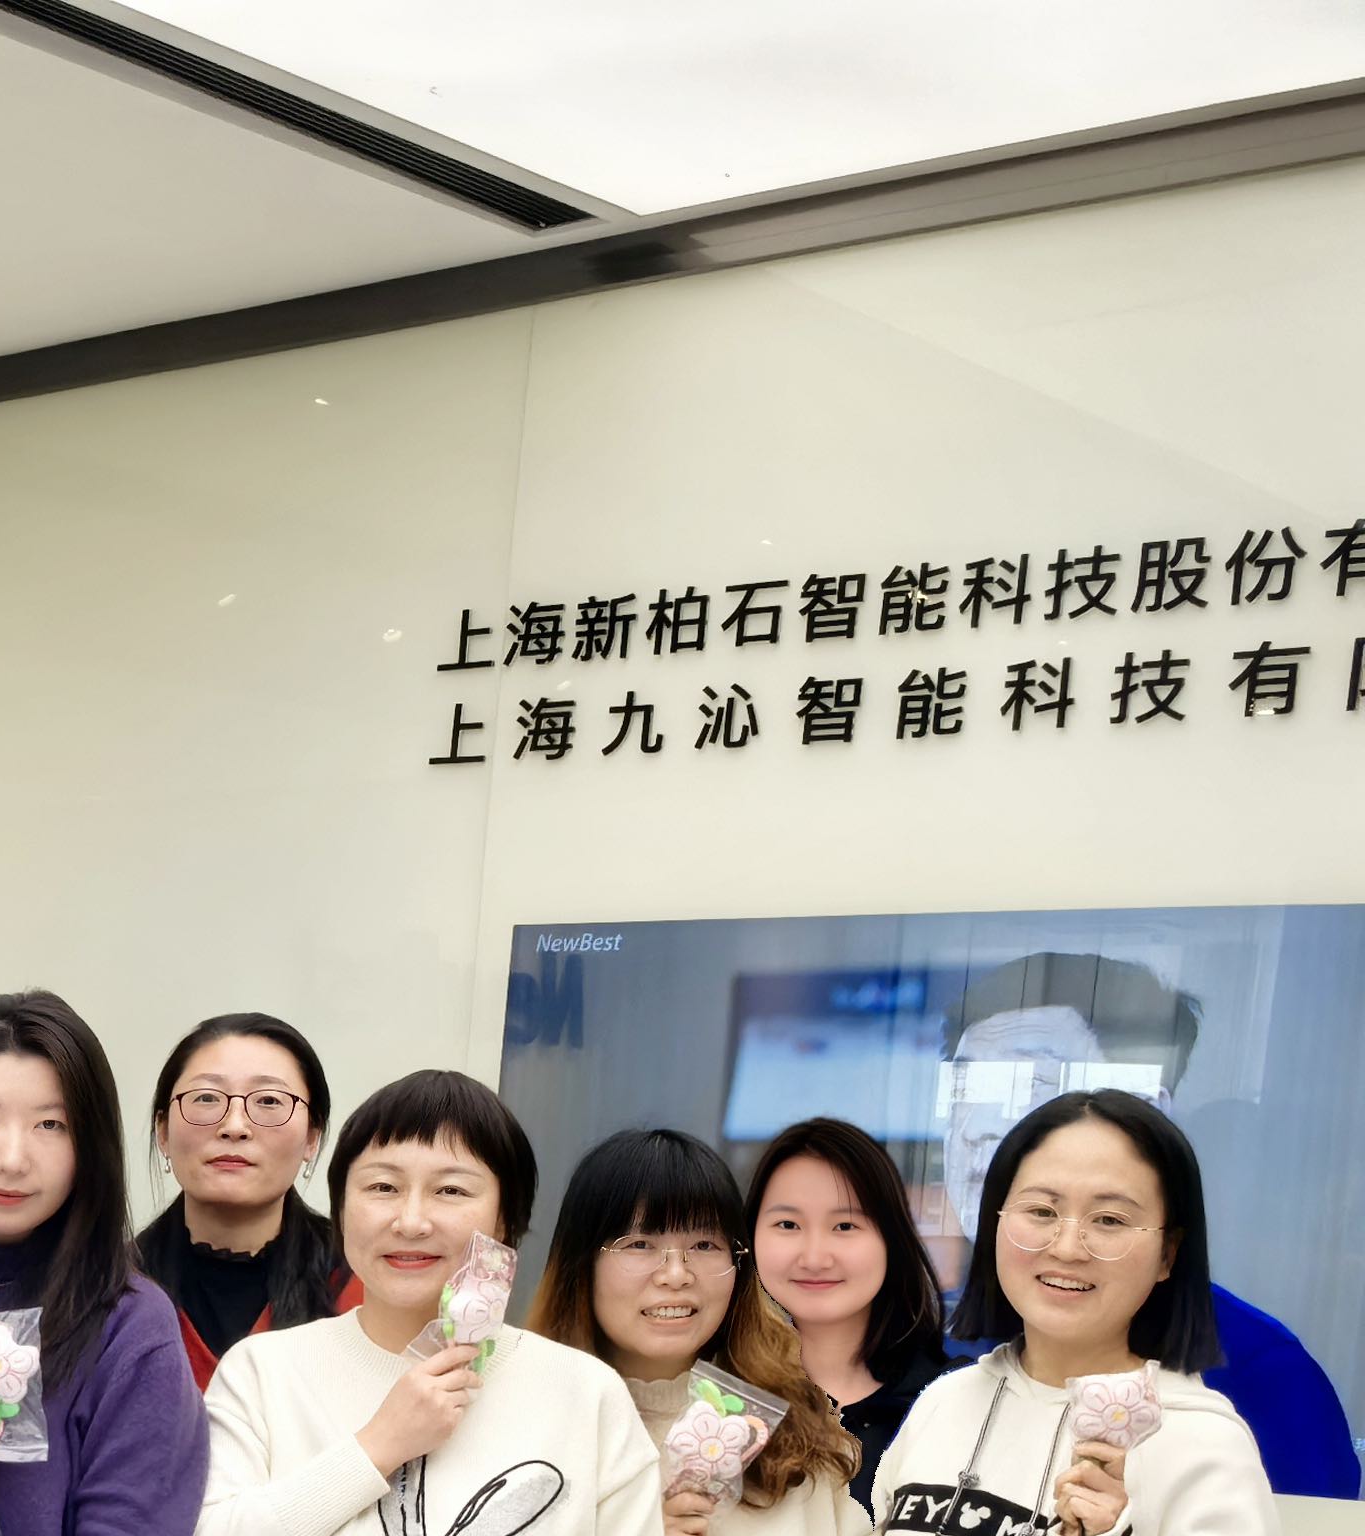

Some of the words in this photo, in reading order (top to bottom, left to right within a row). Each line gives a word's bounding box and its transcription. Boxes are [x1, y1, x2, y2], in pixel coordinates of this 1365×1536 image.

[428, 637, 1365, 765] 上海九沁智能科技有
[536, 932, 623, 952] NewBest
[891, 1494, 951, 1523] EY
